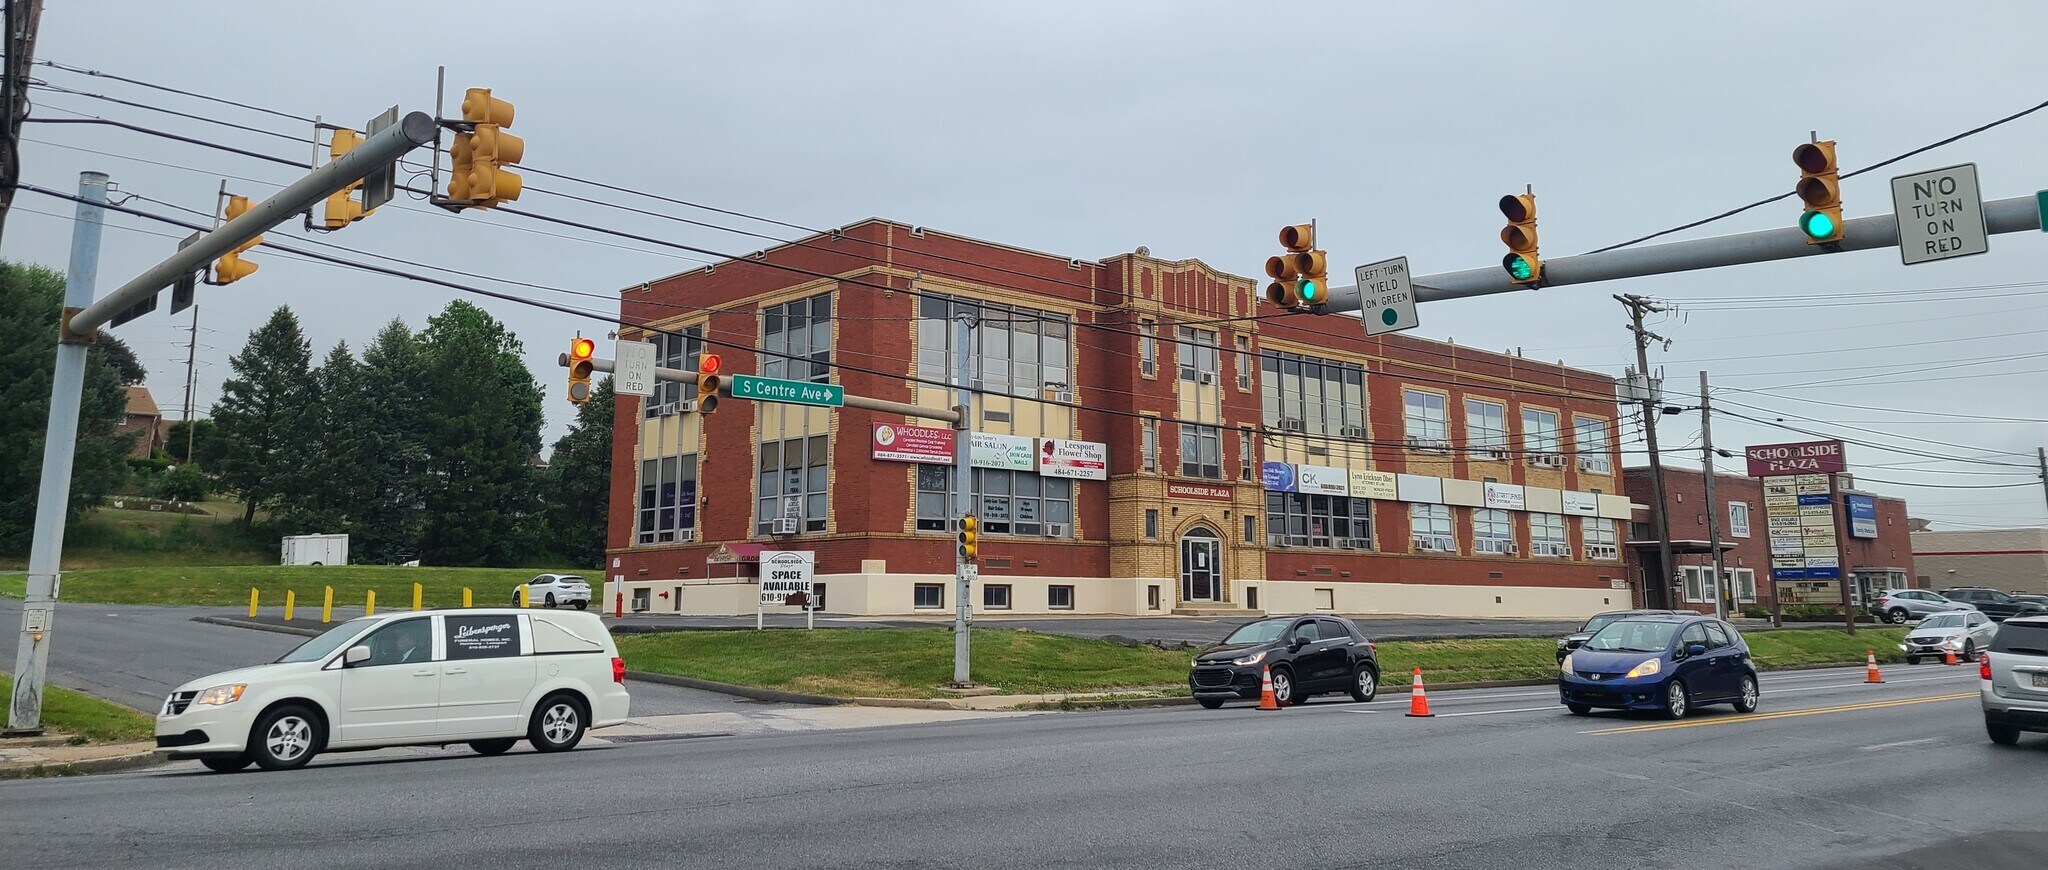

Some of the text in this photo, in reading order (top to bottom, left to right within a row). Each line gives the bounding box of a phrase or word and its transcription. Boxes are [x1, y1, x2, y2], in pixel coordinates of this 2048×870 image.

[1913, 176, 1956, 200] NO
[1912, 198, 1963, 219] TURN
[1927, 218, 1955, 235] ON
[1925, 237, 1962, 254] RED
[1360, 263, 1404, 281] LEFT TURN
[1370, 279, 1398, 294] YIELD
[1366, 292, 1408, 309] ON GREEN
[624, 347, 646, 359] NO
[625, 360, 647, 370] TURN
[629, 371, 641, 380] ON
[626, 381, 643, 391] RED
[743, 380, 822, 400] S Centre Ave
[984, 441, 1007, 450] SALON
[1064, 441, 1095, 451] Leesport
[1058, 448, 1102, 461] Flower Shop
[1749, 444, 1839, 460] SCHOOLSIDE
[1769, 458, 1820, 471] PLAZA
[1054, 468, 1094, 477] 484-671-2257
[1302, 473, 1318, 484] CK
[1352, 472, 1362, 480] Lynn
[1363, 473, 1382, 482] Erickson
[1170, 485, 1230, 497] SCHOOLSIDE PLAZA
[772, 570, 802, 580] SPACE
[763, 581, 810, 591] AVAILABLE
[454, 623, 511, 638] Leibensperger
